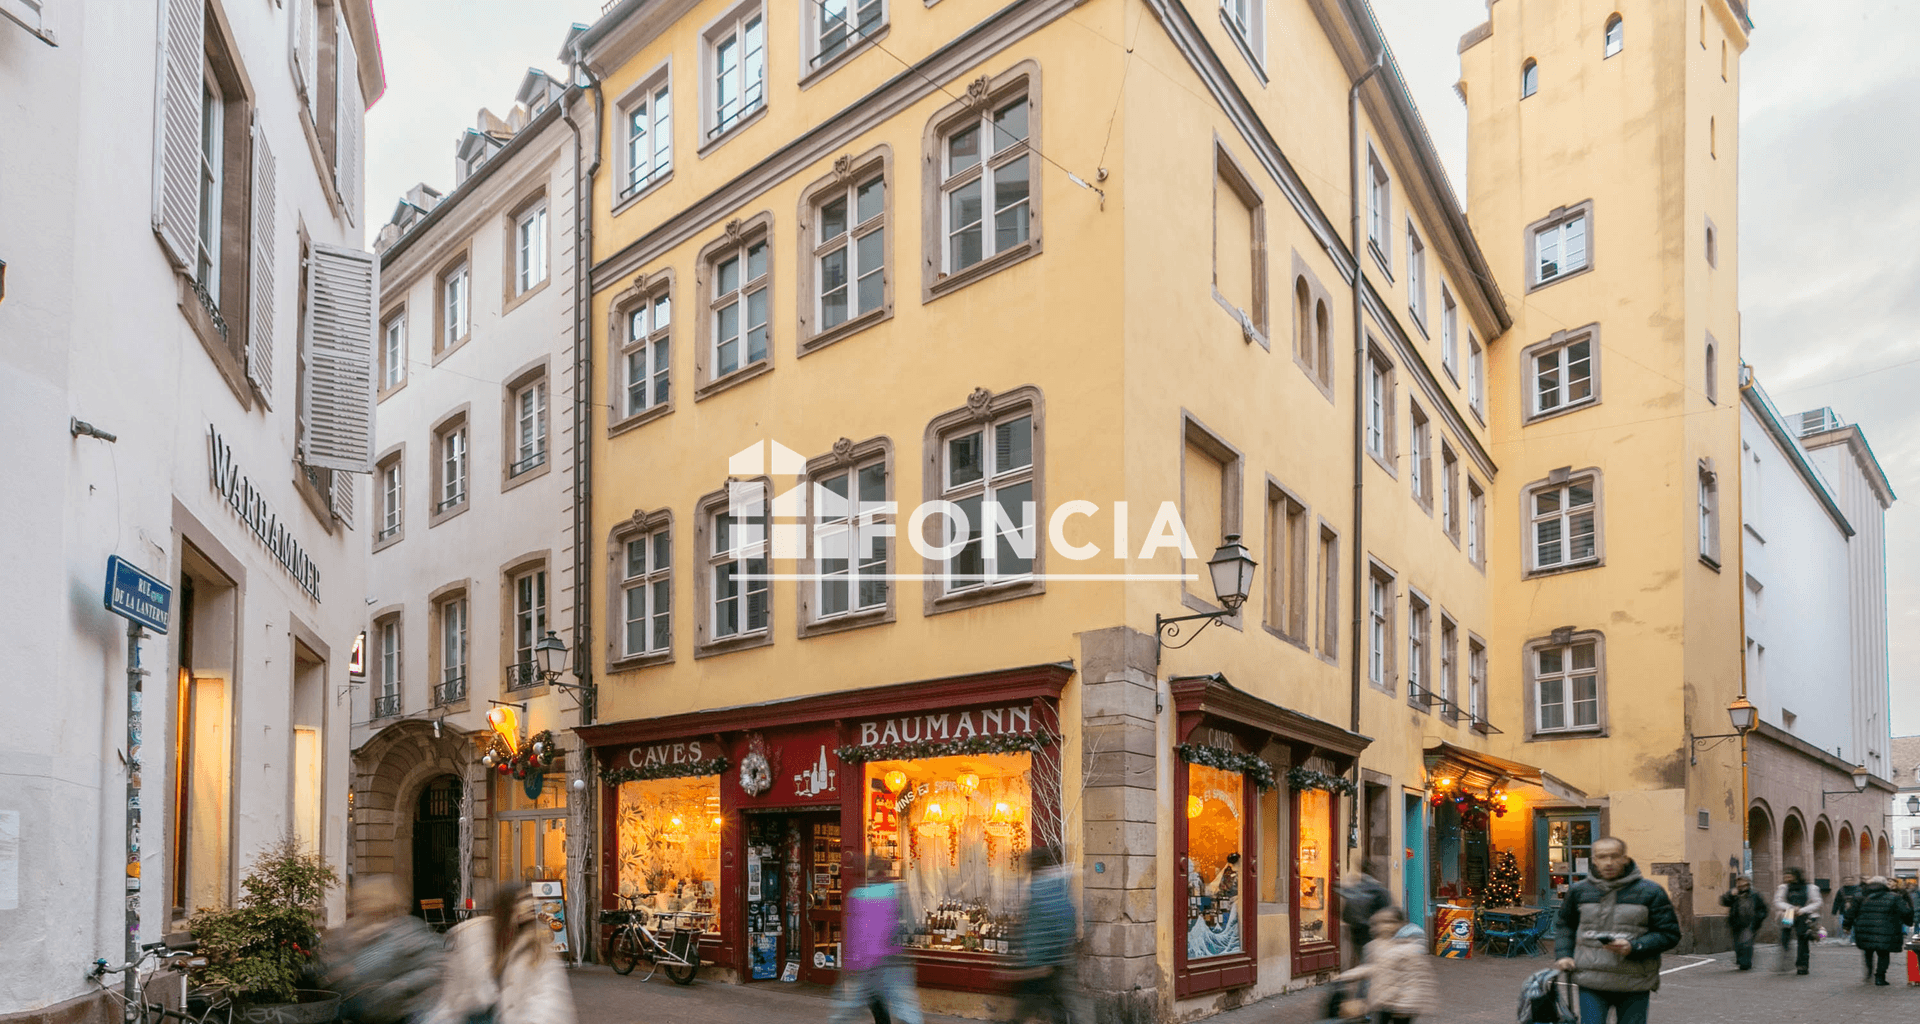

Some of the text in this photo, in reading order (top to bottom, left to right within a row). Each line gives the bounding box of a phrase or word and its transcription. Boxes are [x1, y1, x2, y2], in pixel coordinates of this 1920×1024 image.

[209, 423, 322, 604] WARHAMMER
[138, 578, 152, 597] RUE
[115, 587, 169, 625] DE LA LANTERNE
[628, 705, 1033, 769] CAVES BAUMANN
[1208, 728, 1234, 752] CAVES
[894, 791, 916, 813] VINS
[917, 783, 931, 797] ET
